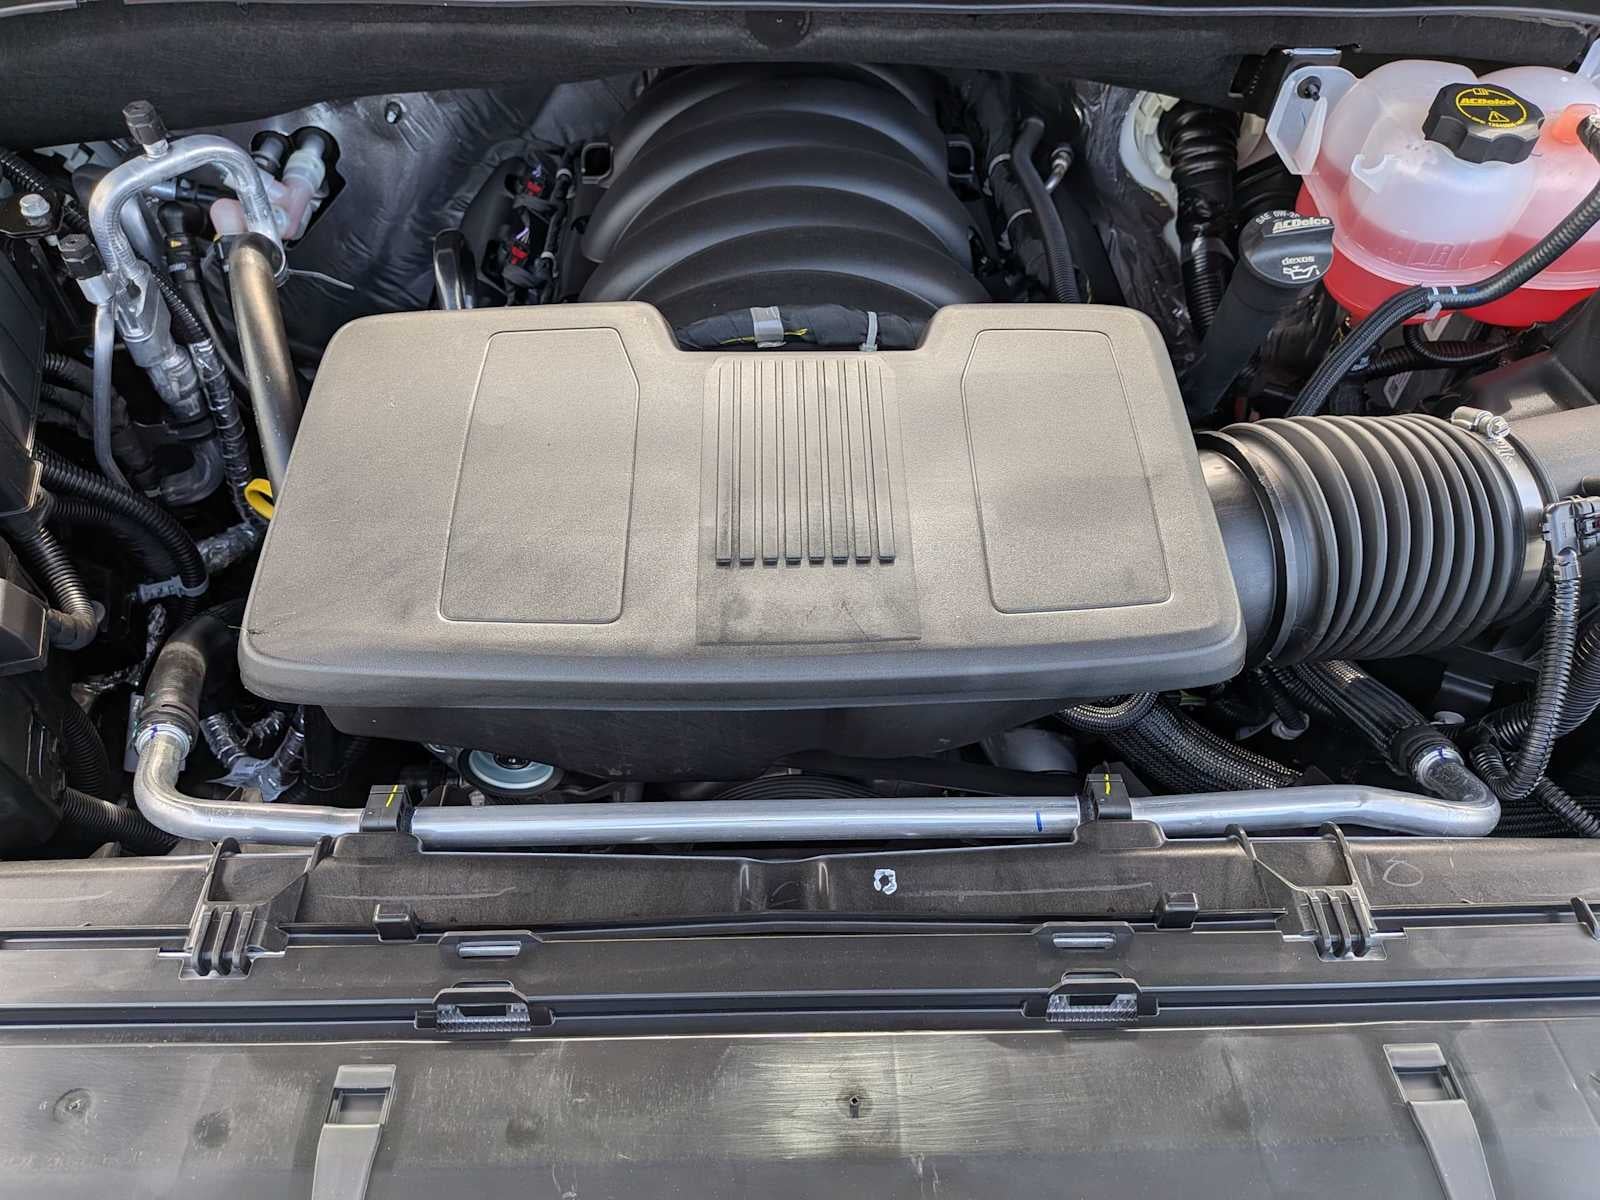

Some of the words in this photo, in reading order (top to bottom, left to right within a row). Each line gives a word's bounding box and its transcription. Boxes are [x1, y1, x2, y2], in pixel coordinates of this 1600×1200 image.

[1460, 98, 1515, 106] ACDelco
[1256, 211, 1272, 224] SAE
[1272, 217, 1330, 232] ACDelco
[1282, 256, 1315, 265] dexos
